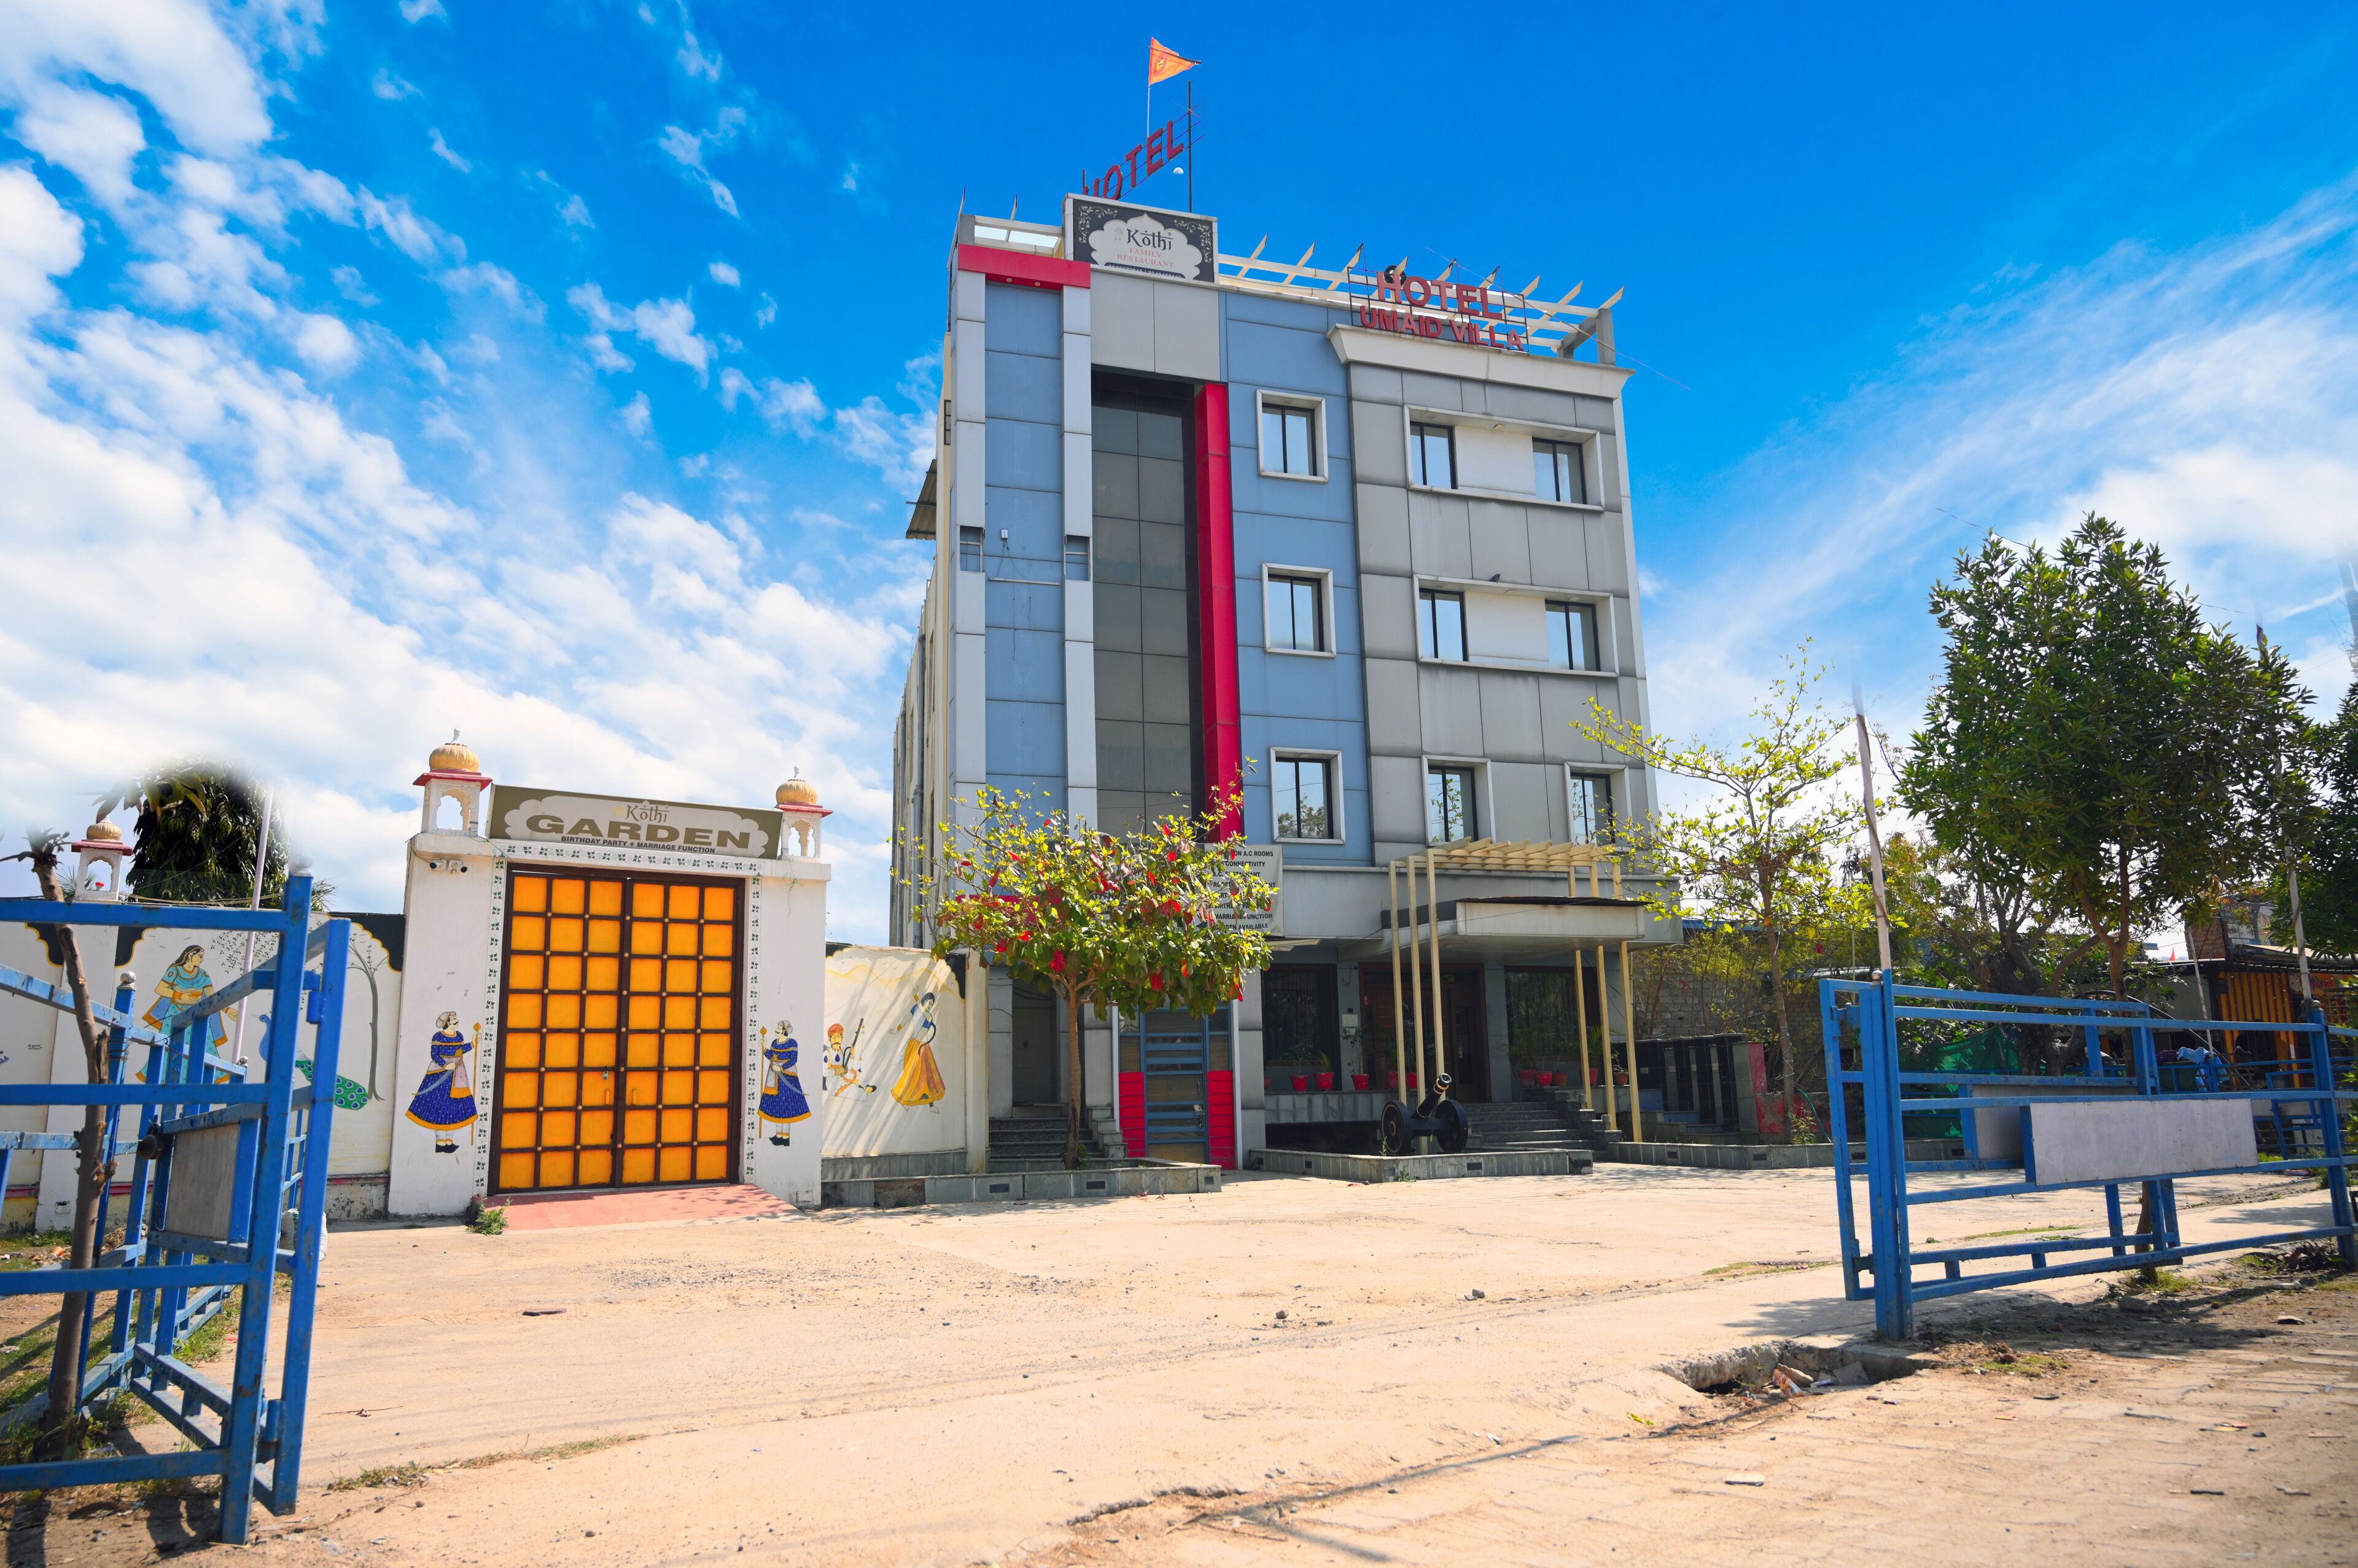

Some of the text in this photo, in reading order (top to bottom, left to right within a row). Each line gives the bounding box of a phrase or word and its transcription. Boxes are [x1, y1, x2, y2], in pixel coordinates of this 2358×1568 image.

[1116, 254, 1175, 268] RESTAURANT
[1129, 247, 1162, 258] FAMILY
[1376, 271, 1503, 319] HOTEL
[1360, 305, 1524, 352] UMAID VILLA
[526, 813, 751, 850] GARDEN
[561, 836, 601, 845] BIRTHDAY
[637, 842, 676, 850] MARRIAGE
